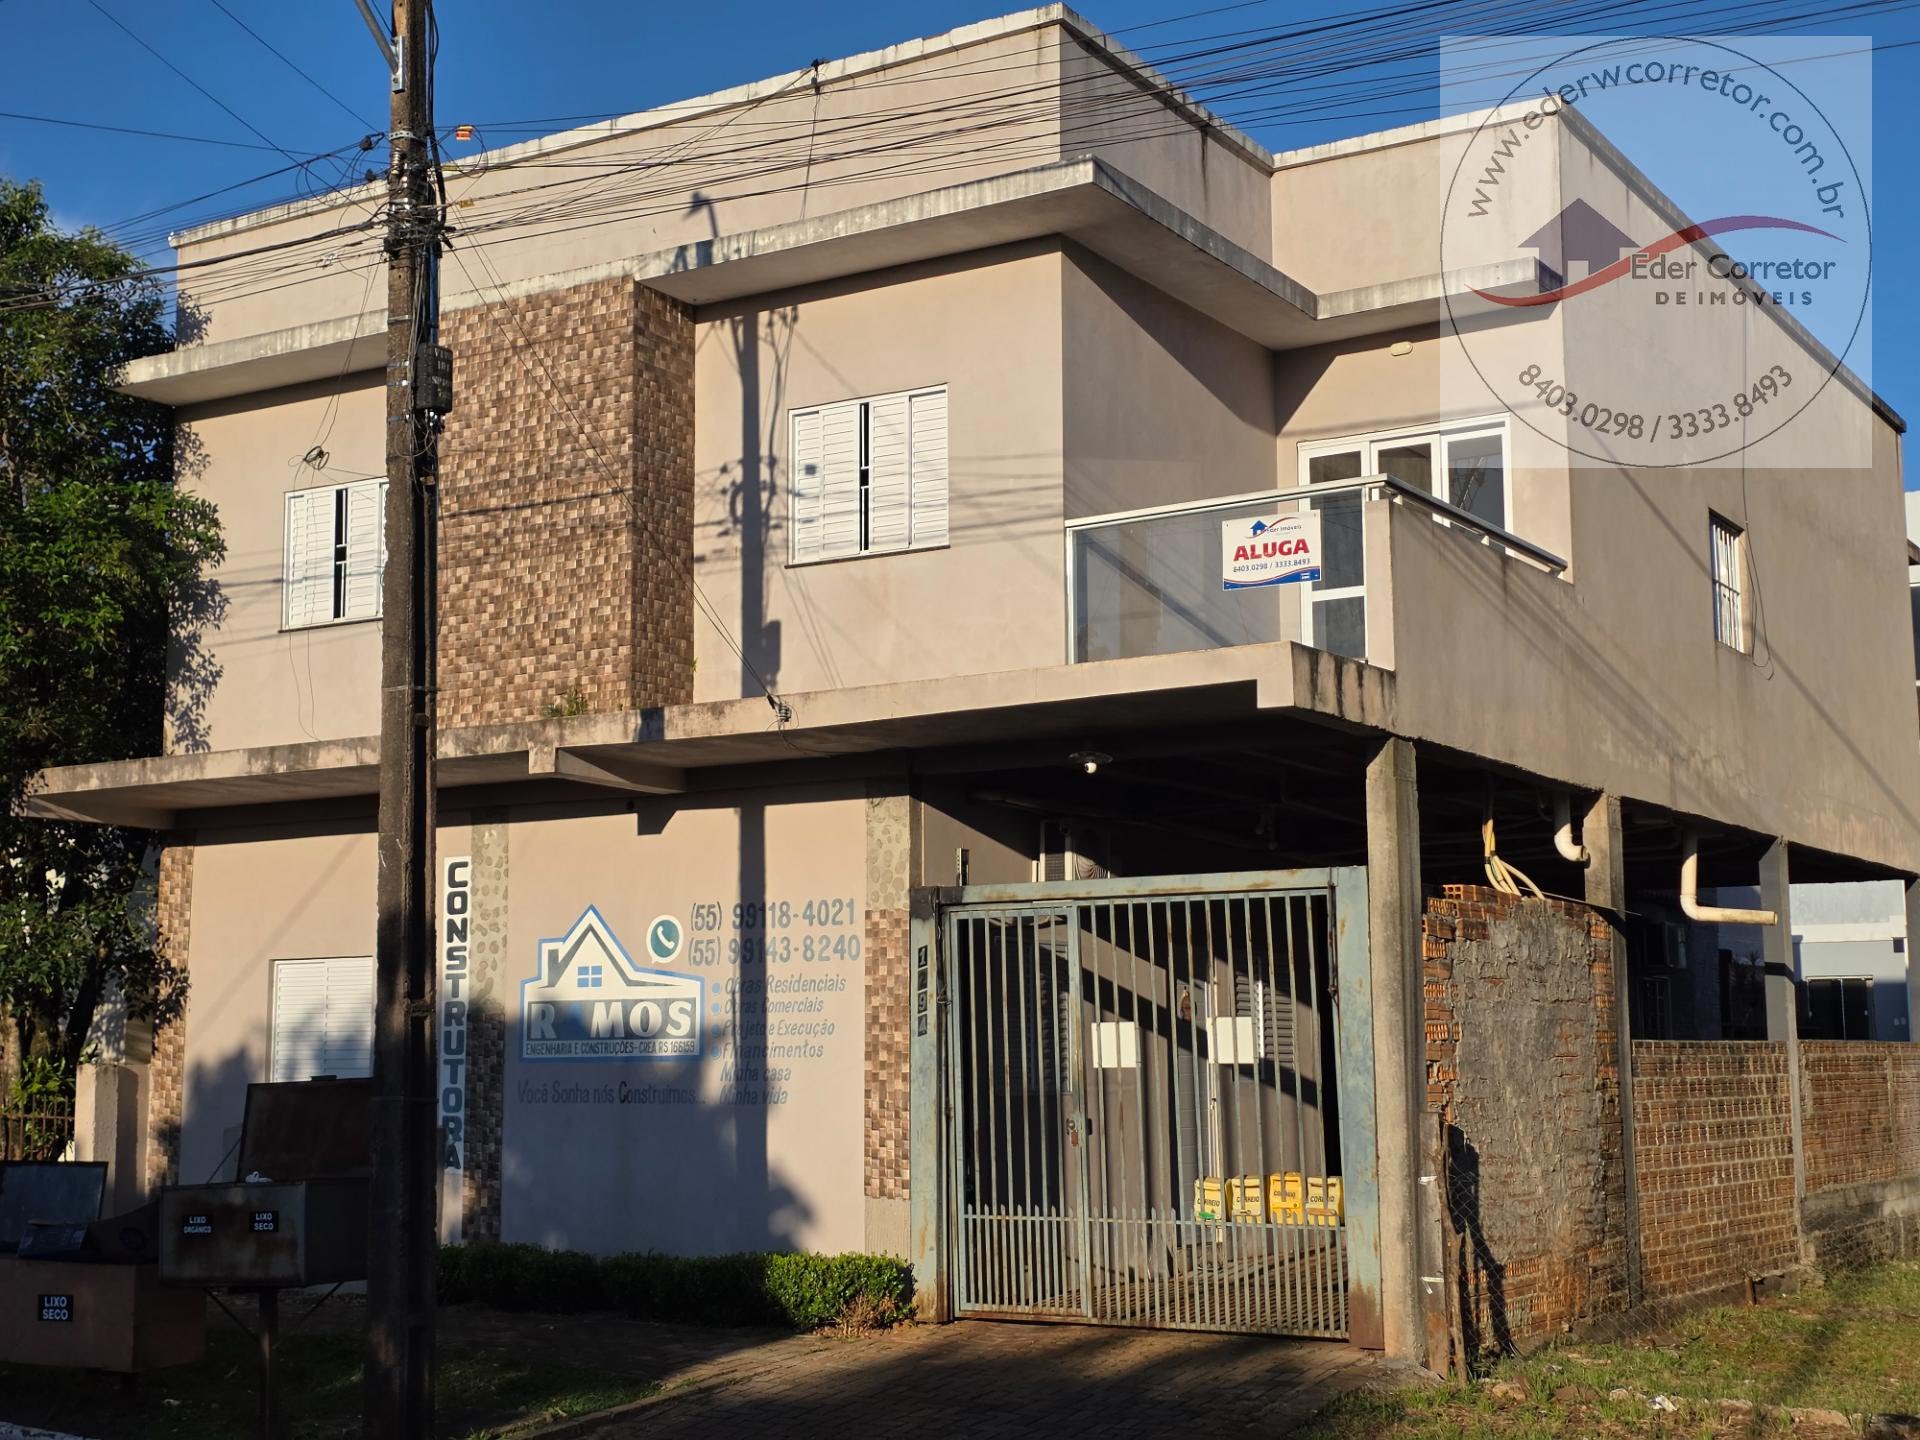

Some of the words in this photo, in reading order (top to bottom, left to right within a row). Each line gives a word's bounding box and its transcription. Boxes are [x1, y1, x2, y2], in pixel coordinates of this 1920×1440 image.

[1233, 538, 1310, 561] ALUGA
[691, 901, 722, 931] (55)
[732, 898, 855, 931] 99118-4021
[688, 936, 721, 966] (55)
[728, 934, 861, 964] 99143-8240
[725, 976, 761, 994] Obras
[766, 973, 846, 994] Residenciais
[441, 860, 469, 1170] CONSTRUTORA
[725, 998, 757, 1015] Obras
[761, 996, 823, 1014] Comerciais
[768, 1023, 775, 1036] e
[777, 1018, 835, 1038] Execução
[720, 1063, 758, 1082] Minha
[763, 1067, 791, 1082] casa
[551, 1080, 590, 1104] Sonha
[593, 1084, 615, 1104] nós
[720, 1084, 758, 1105] Minha
[762, 1087, 788, 1104] vida
[189, 1215, 207, 1224] LIXO
[255, 1212, 273, 1220] LIXO
[253, 1222, 274, 1231] SECO
[44, 1295, 68, 1308] LIXO
[42, 1308, 69, 1320] SECO
